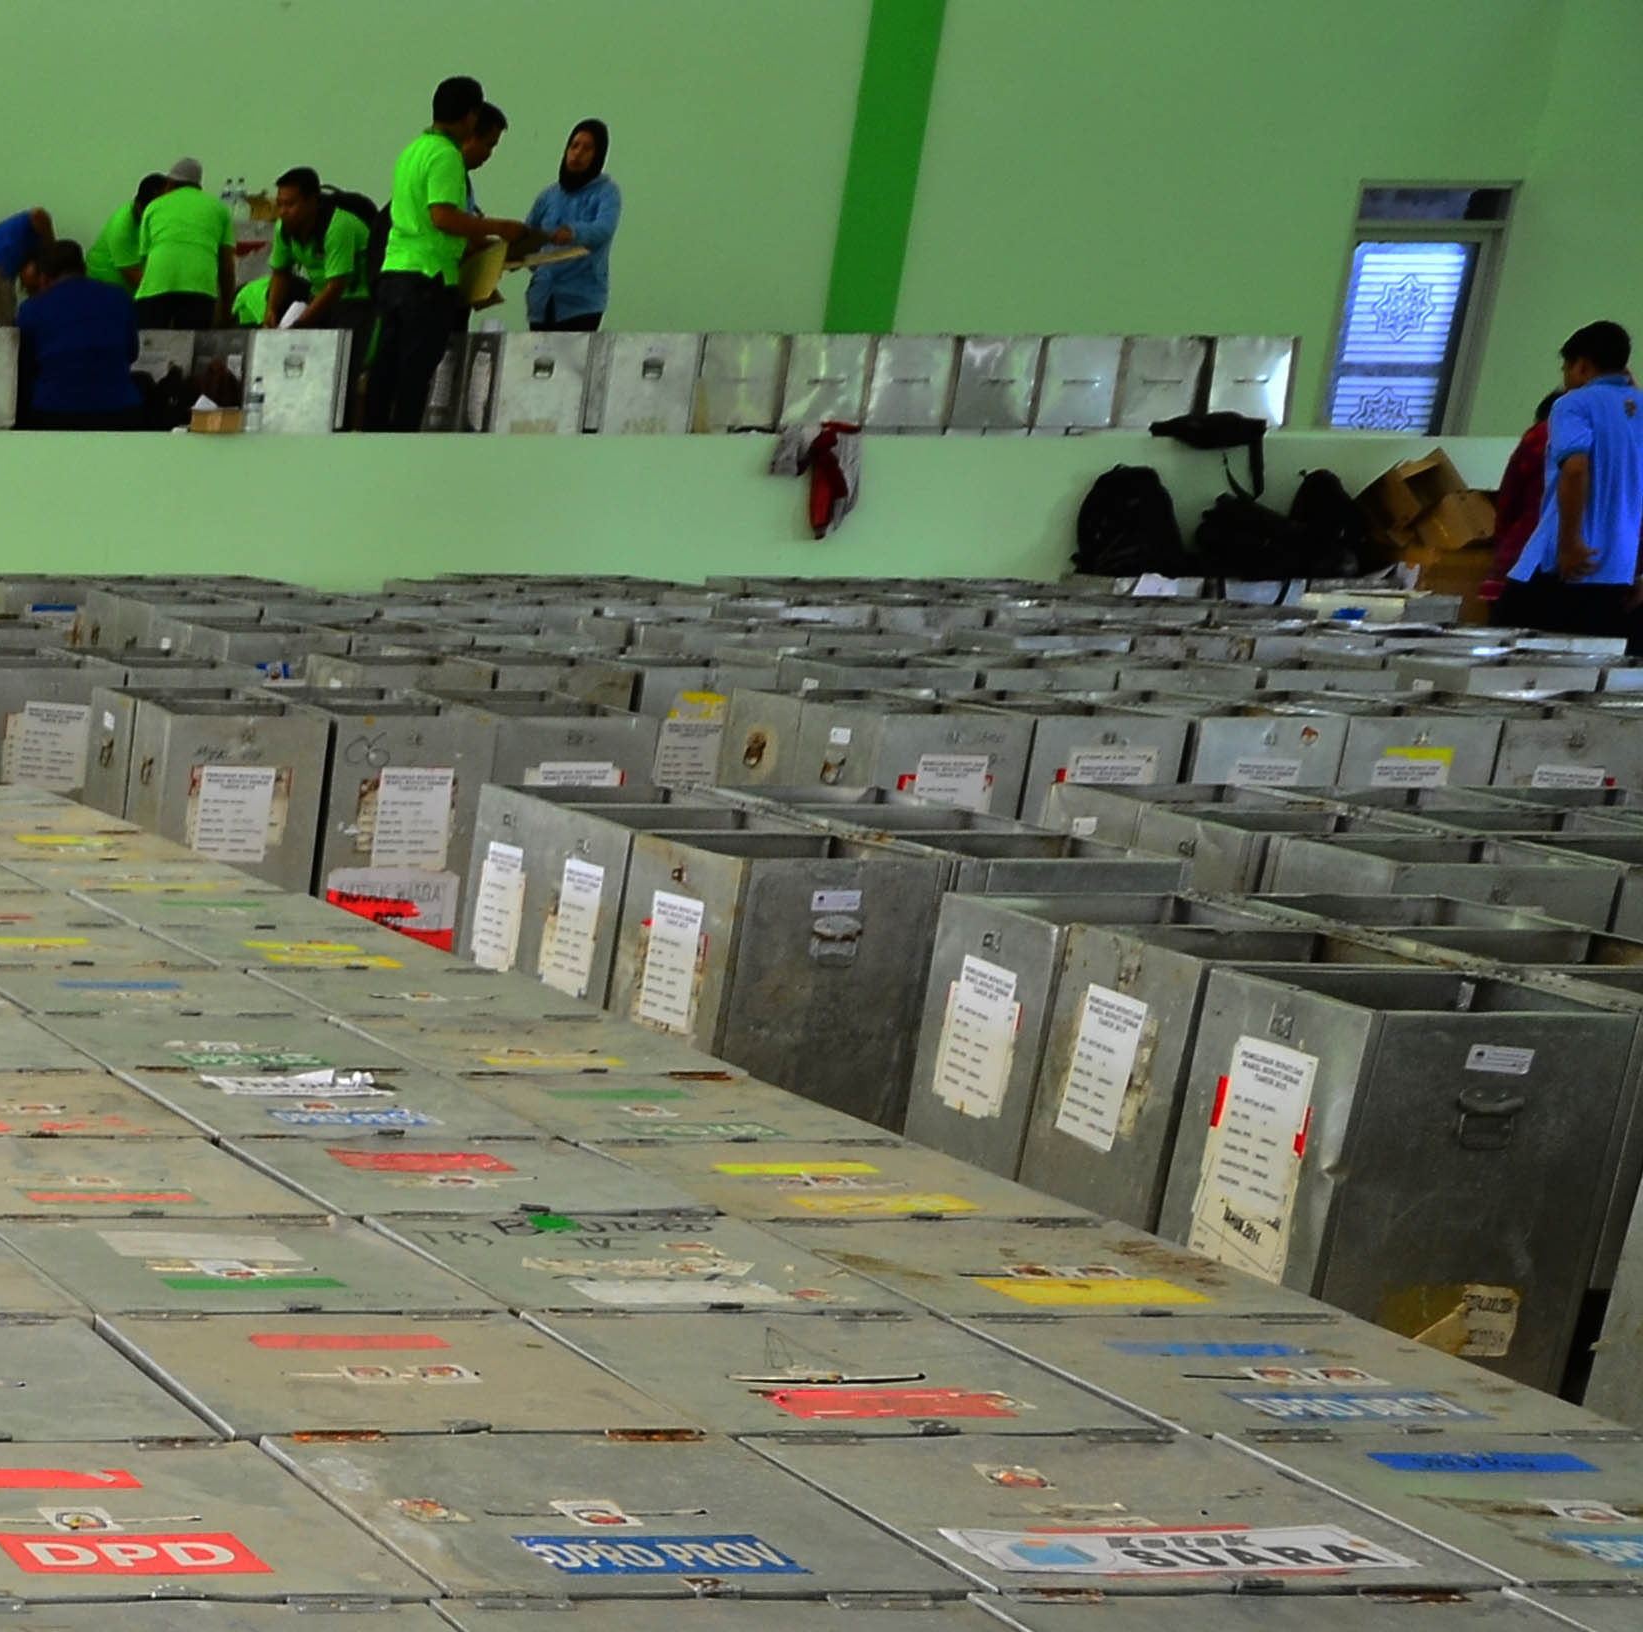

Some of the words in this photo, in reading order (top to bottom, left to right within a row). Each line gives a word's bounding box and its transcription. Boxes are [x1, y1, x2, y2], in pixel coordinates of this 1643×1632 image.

[27, 1540, 238, 1569] DPD
[543, 1538, 653, 1571] DPRD
[656, 1539, 789, 1571] PROV
[1117, 1543, 1390, 1569] SUARA
